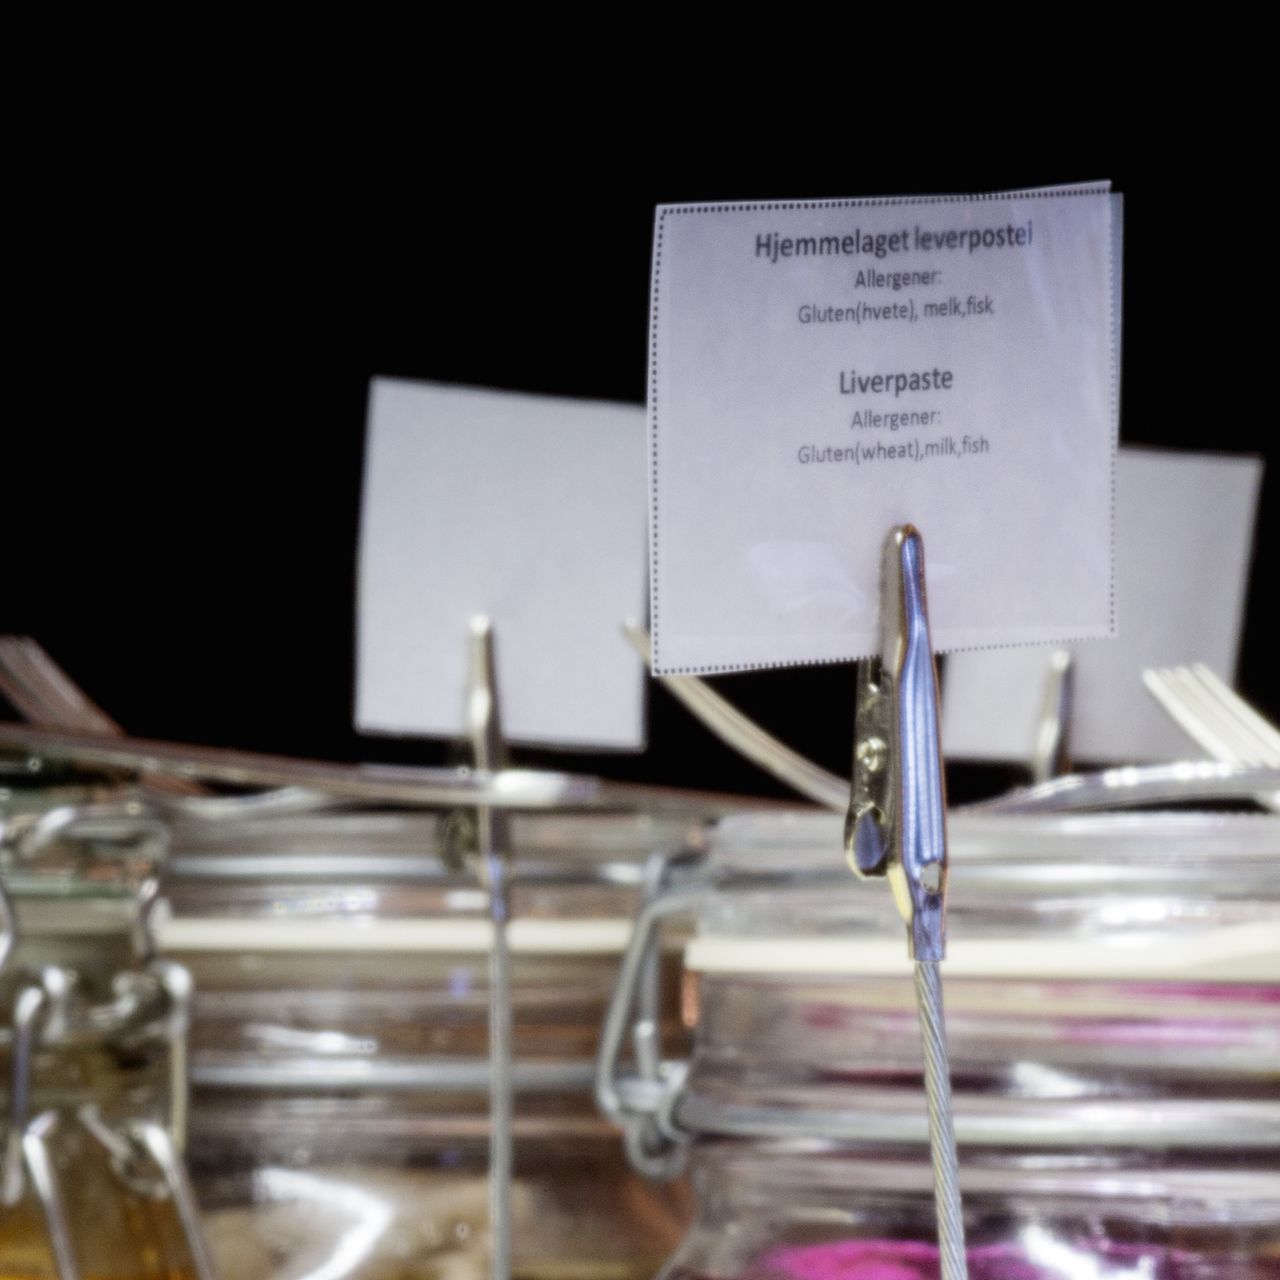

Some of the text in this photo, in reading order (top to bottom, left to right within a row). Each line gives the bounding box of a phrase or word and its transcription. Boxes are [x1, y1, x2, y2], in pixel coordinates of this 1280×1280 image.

[754, 220, 1033, 263] Hjemmelaget leverpostei
[854, 268, 942, 290] Allergener:
[798, 296, 994, 325] Gluten(hvete), melk,fisk
[838, 367, 953, 397] Liverpaste
[850, 409, 941, 431] Allergener:
